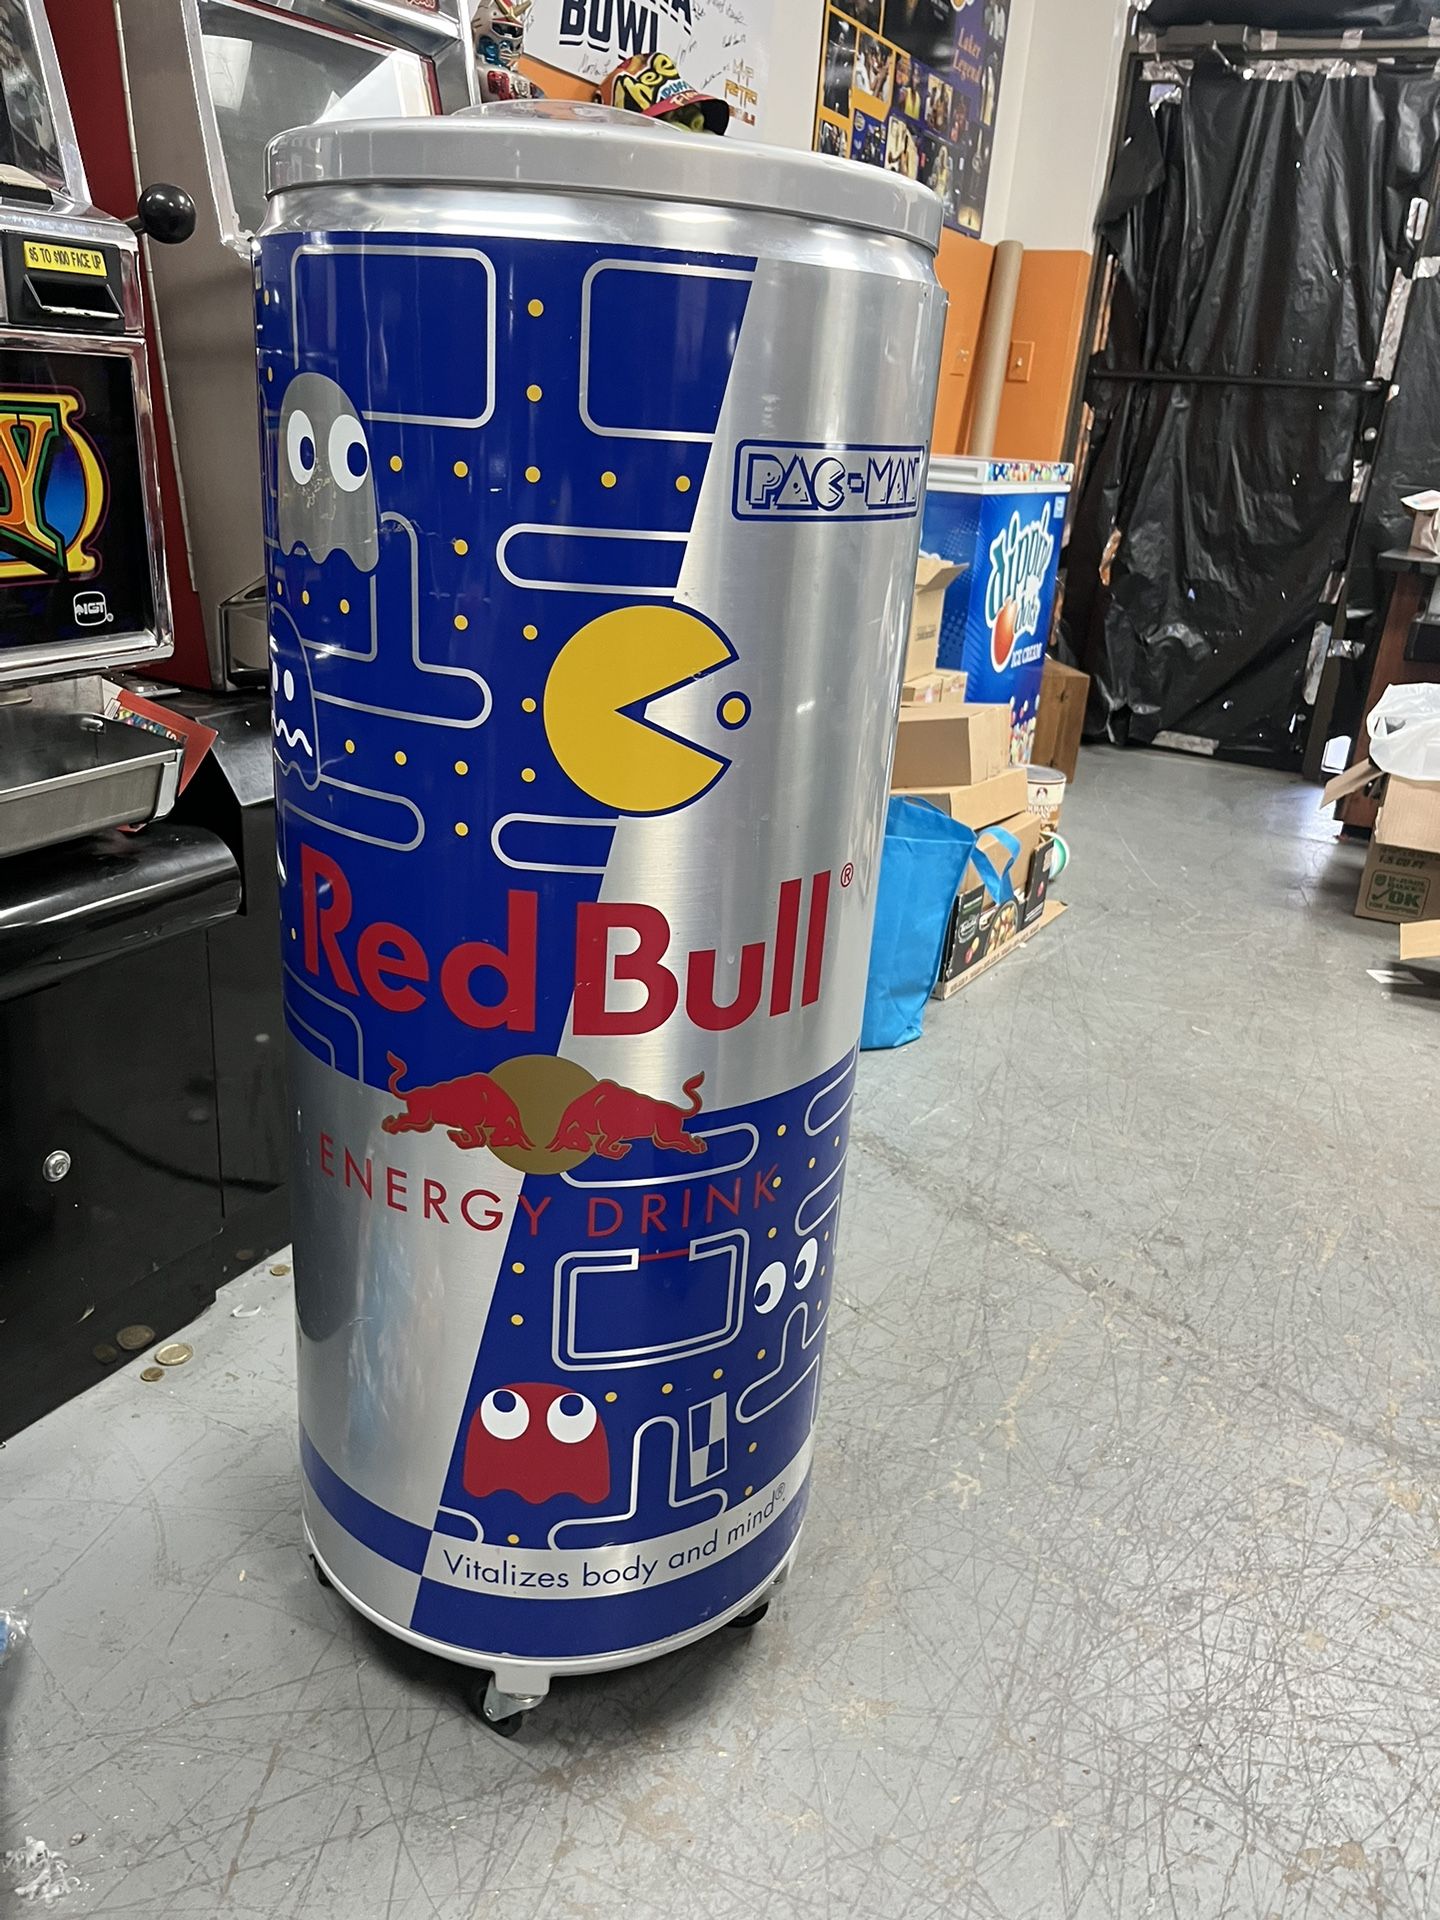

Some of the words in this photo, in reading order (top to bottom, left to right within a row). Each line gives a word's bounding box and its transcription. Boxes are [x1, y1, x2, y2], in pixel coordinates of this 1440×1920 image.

[40, 248, 52, 264] TO
[72, 250, 91, 269] FACE
[92, 254, 102, 270] UP
[746, 453, 919, 511] PAC-MAN
[301, 843, 537, 1032] Red
[319, 1132, 551, 1237] ENERGY
[587, 1164, 779, 1238] DRINK
[443, 1549, 569, 1588] Vitalizes
[583, 1555, 659, 1587] body
[668, 1530, 717, 1569] and
